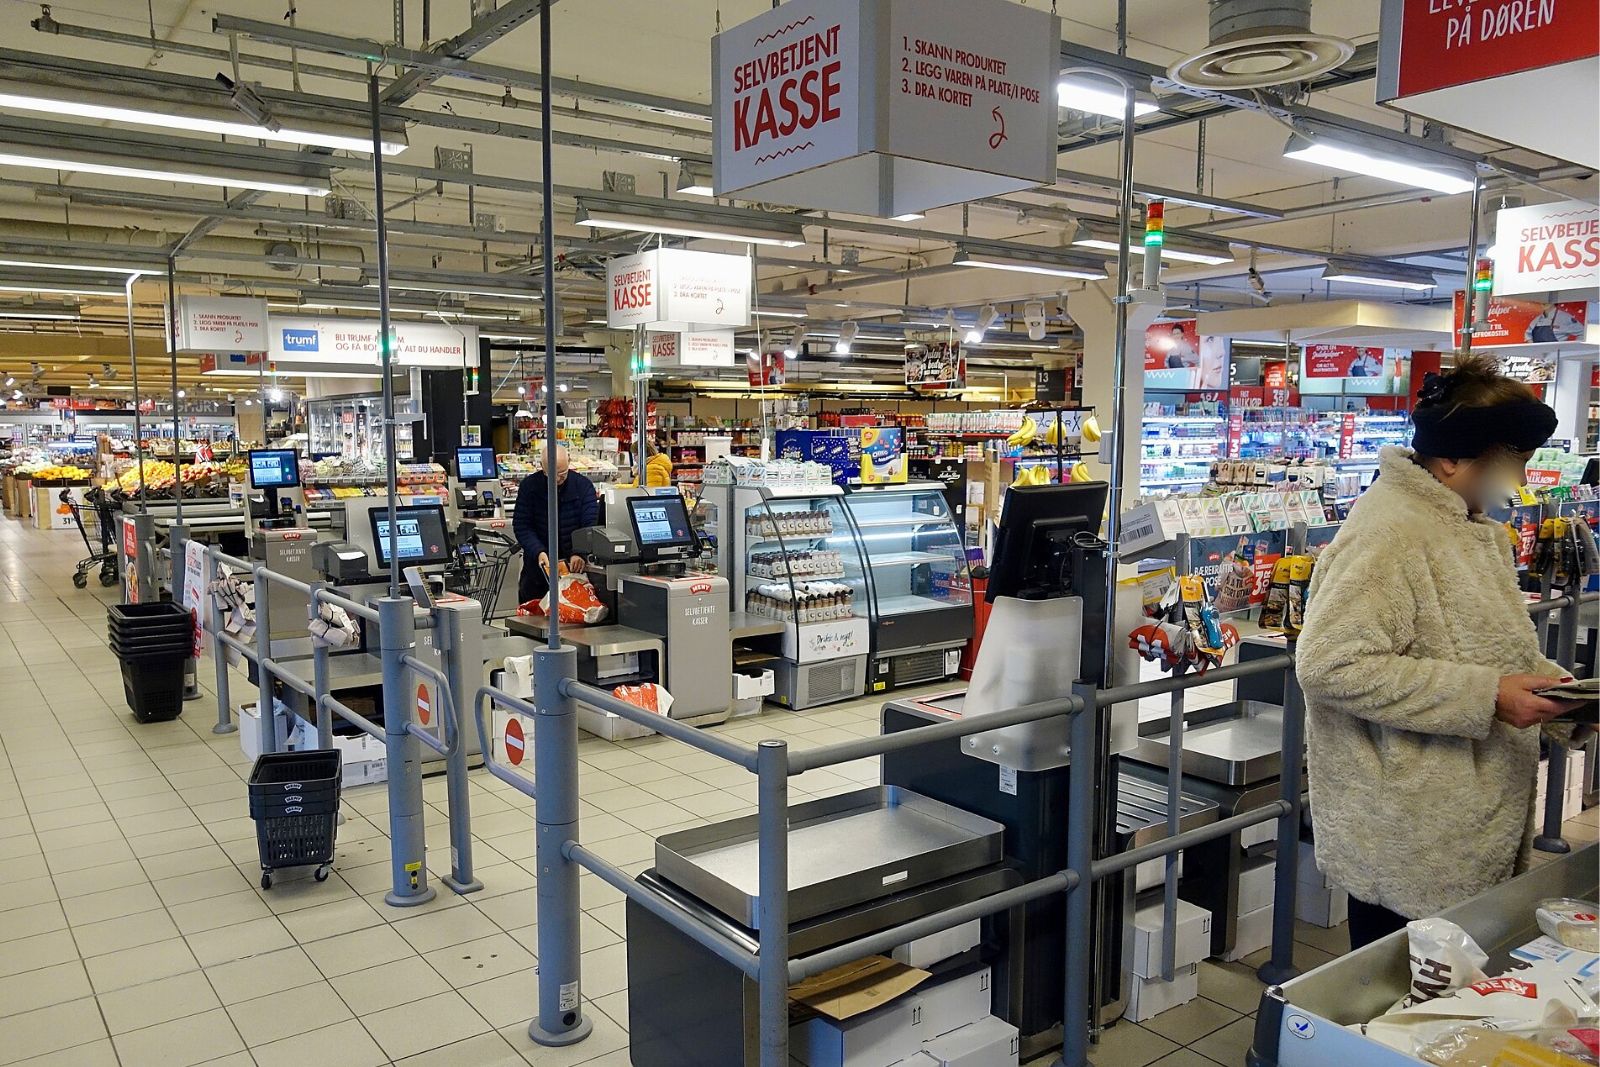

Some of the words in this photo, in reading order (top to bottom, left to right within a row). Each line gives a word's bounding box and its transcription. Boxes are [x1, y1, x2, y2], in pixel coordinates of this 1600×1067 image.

[1446, 6, 1471, 50] PÅ
[1480, 0, 1555, 41] DØREN
[734, 25, 841, 94] SELVBETJENT
[902, 36, 912, 52] 1.
[915, 40, 952, 61] SKANN
[955, 51, 1007, 76] PRODUKTET
[902, 58, 912, 74] 2.
[916, 61, 942, 79] LEGG
[944, 68, 972, 86] VAREN
[976, 74, 986, 90] PÅ
[988, 79, 1018, 100] PLATE/I
[1020, 87, 1040, 104] POSE
[902, 79, 912, 94] 3.
[915, 82, 936, 98] DRA
[938, 88, 973, 108] KORTET
[734, 61, 841, 152] KASSE
[614, 269, 652, 287] SELVBETJENT
[614, 283, 652, 311] KASSE
[286, 334, 316, 345] trumf
[430, 346, 461, 354] HANDLER
[652, 342, 676, 357] KASSE
[1038, 372, 1048, 382] 13
[692, 584, 710, 592] MENY
[1252, 571, 1264, 596] 3
[1474, 979, 1529, 995] MENY
